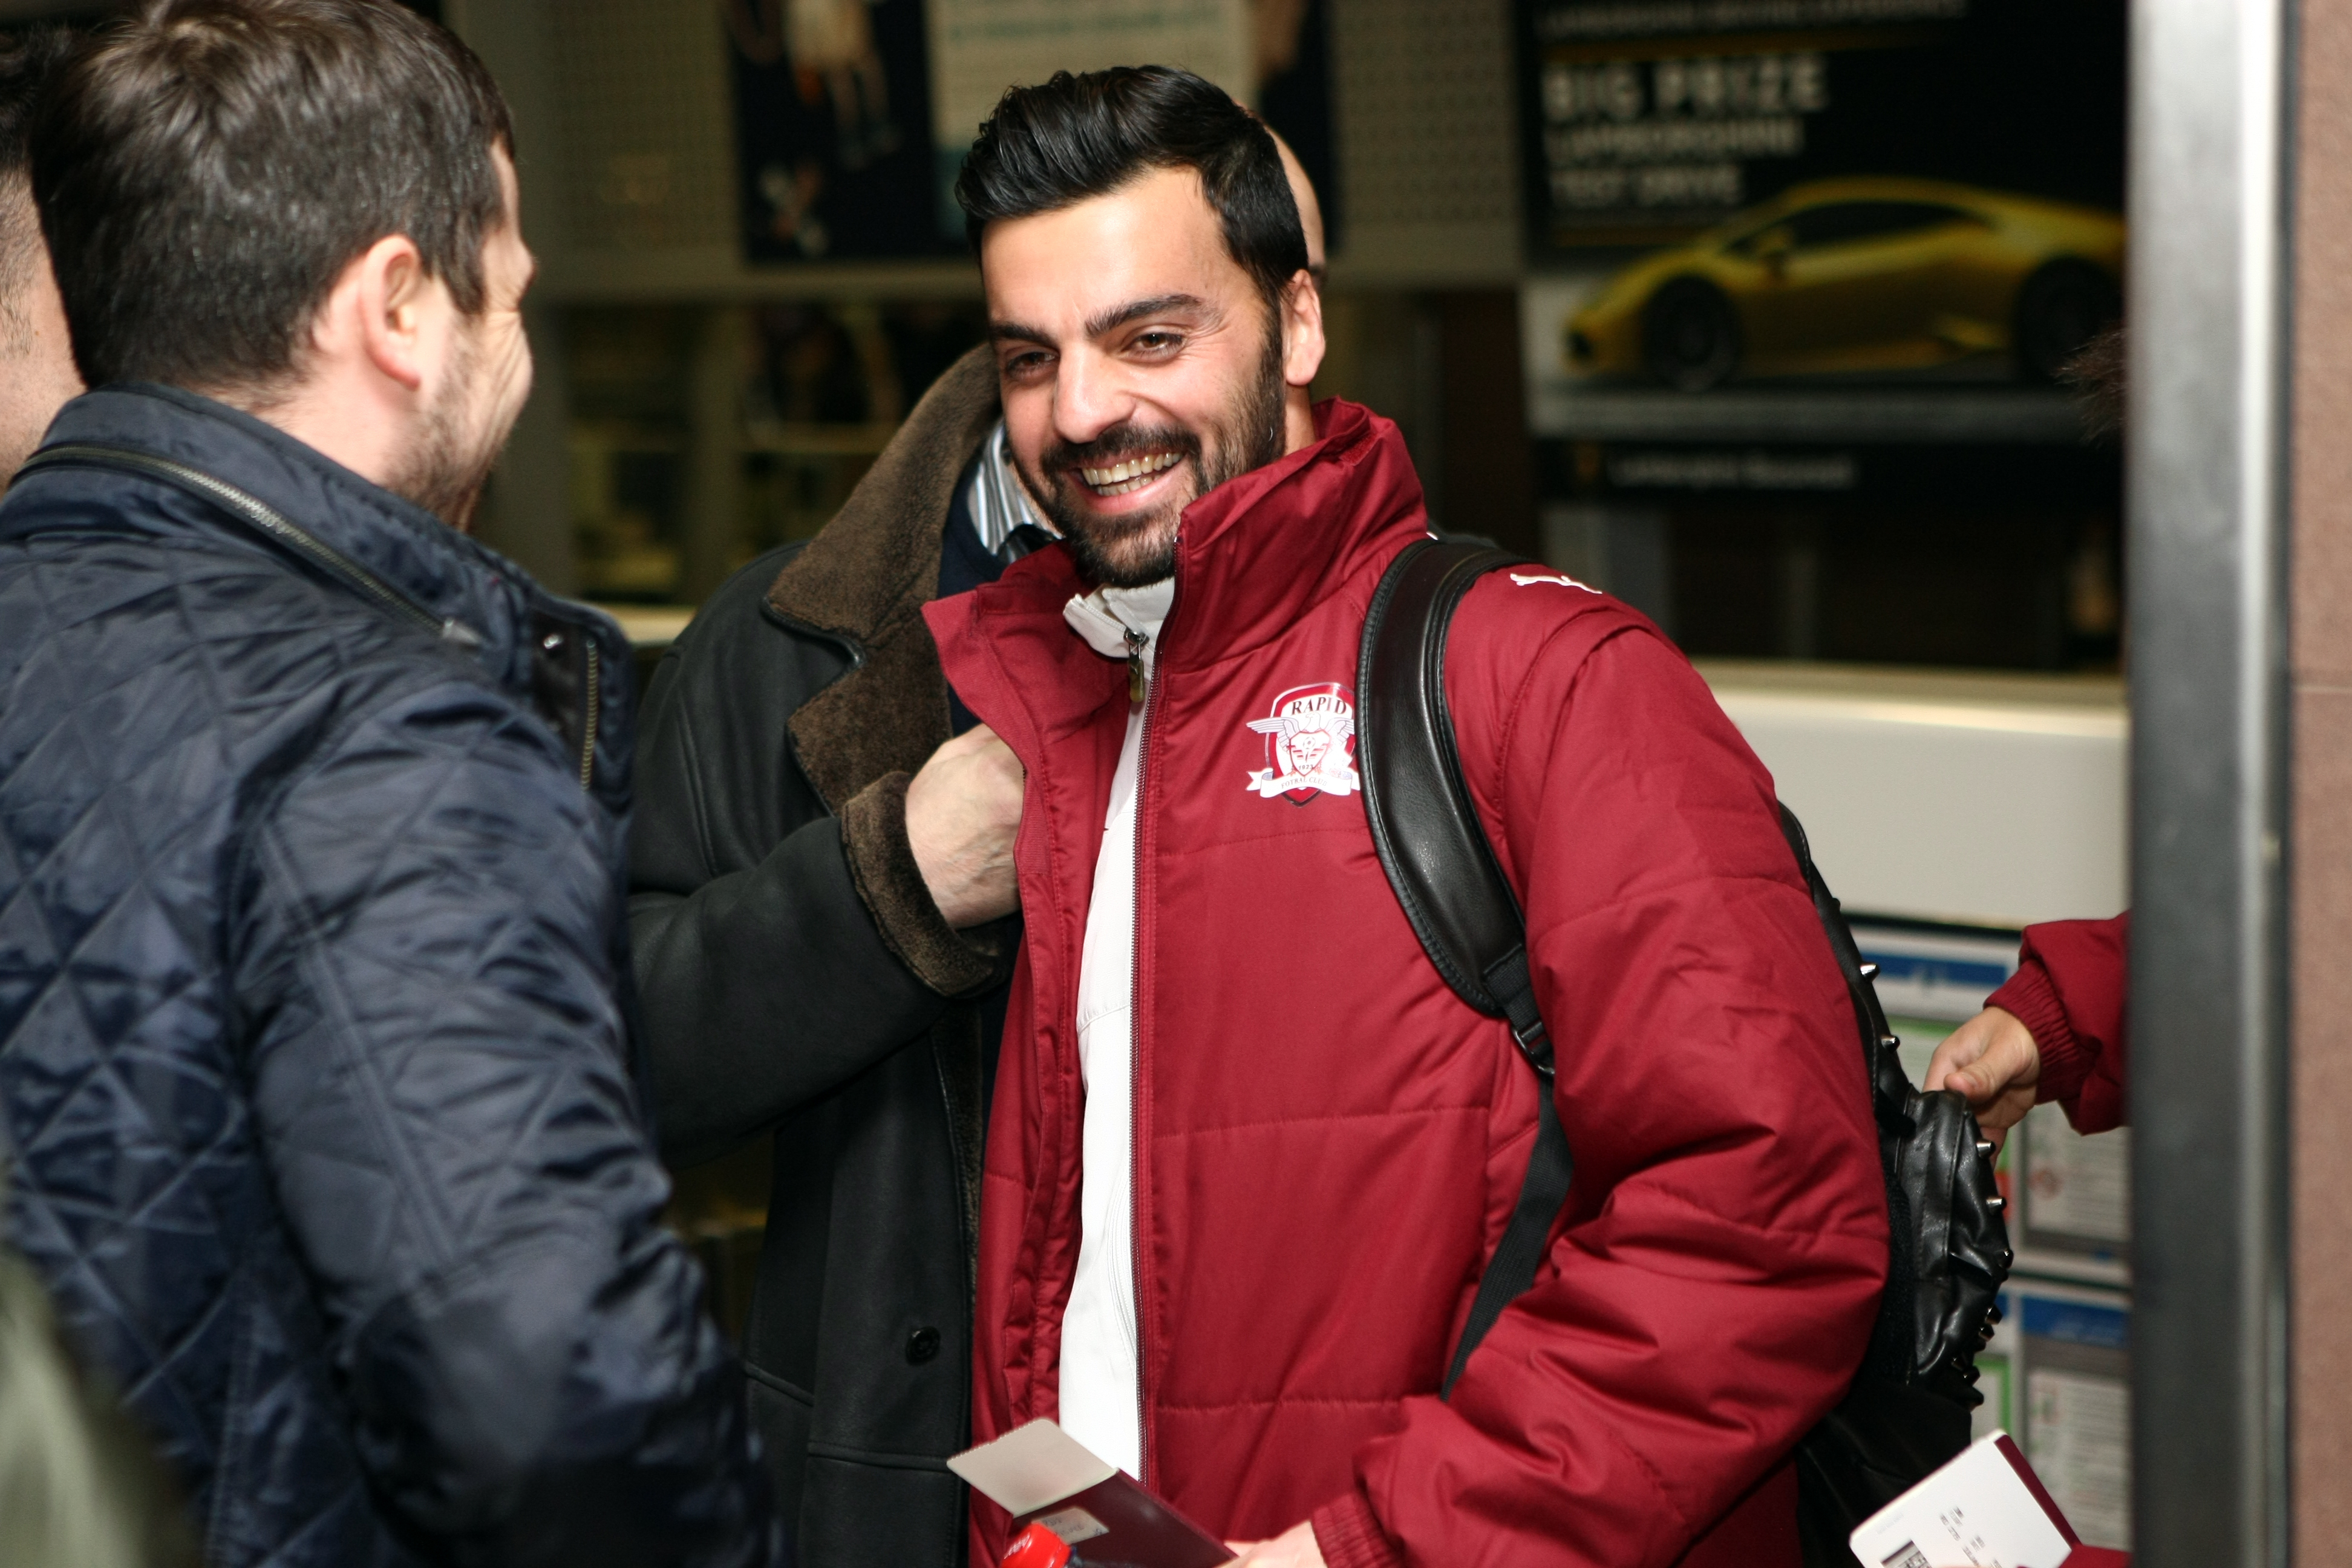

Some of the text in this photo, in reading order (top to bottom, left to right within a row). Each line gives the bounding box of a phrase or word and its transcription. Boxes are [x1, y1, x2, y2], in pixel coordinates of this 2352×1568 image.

[1541, 54, 1828, 120] BIG PRIZE
[1291, 696, 1347, 716] RAPID
[1281, 777, 1328, 789] FOTBAL CLUB
